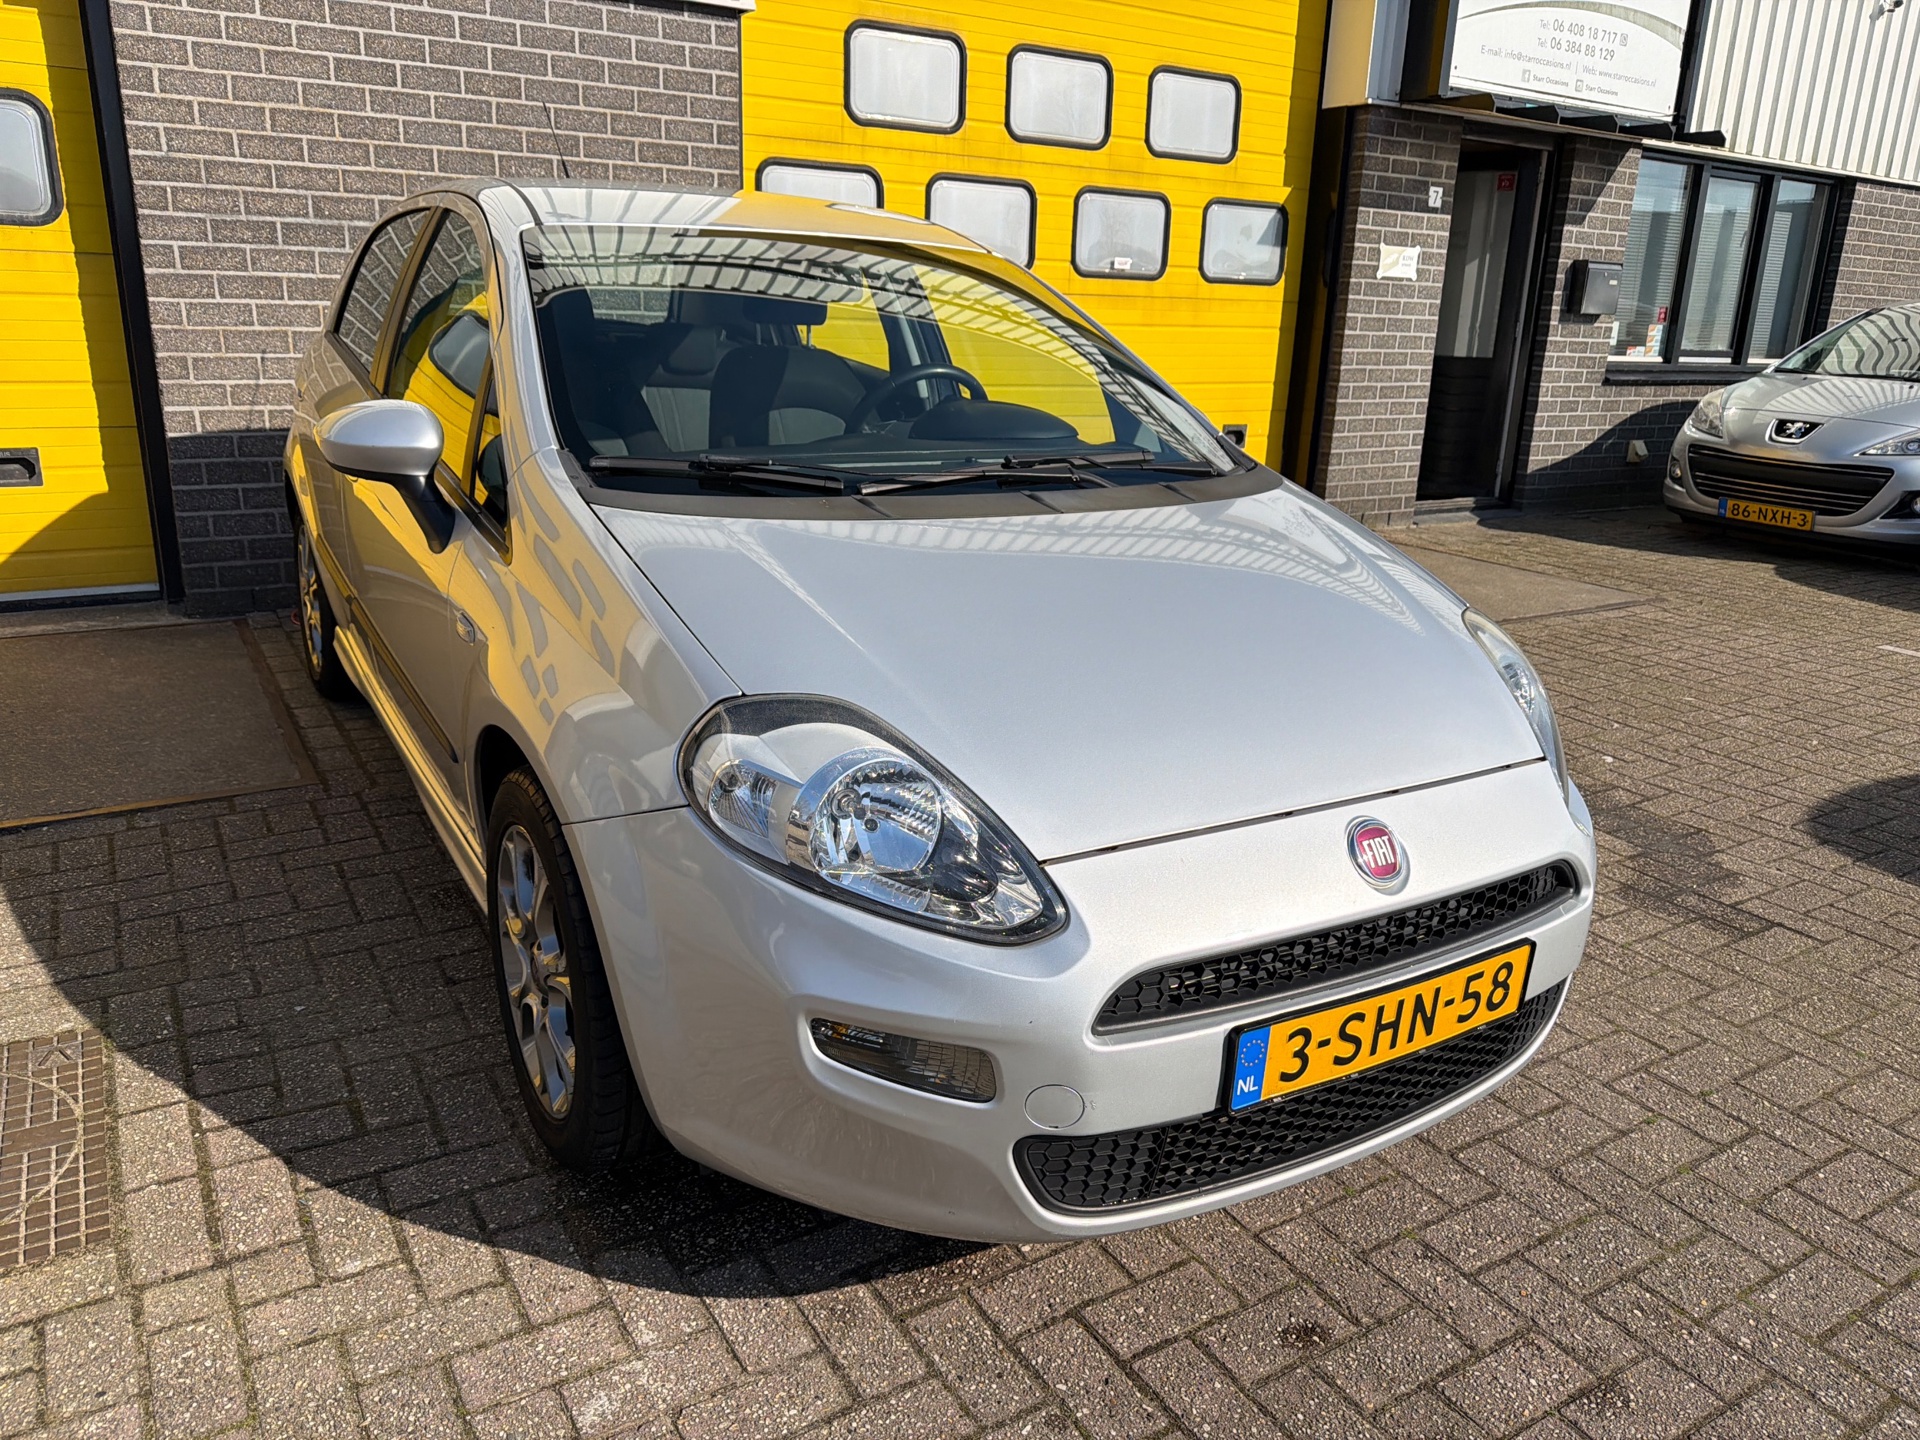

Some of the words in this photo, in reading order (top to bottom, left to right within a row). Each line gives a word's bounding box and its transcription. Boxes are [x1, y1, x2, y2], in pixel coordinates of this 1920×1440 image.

[1540, 19, 1551, 31] Tel:
[1553, 18, 1565, 33] 06
[1567, 22, 1585, 37] 408
[1588, 26, 1599, 40] 18
[1601, 29, 1618, 44] 717
[1537, 37, 1548, 49] Tel:
[1550, 36, 1562, 51] 06
[1564, 39, 1582, 55] 384
[1584, 44, 1596, 58] 88
[1599, 47, 1615, 61] 129
[1480, 44, 1503, 58] E-mail:
[1504, 48, 1572, 71] info@starroccasions.nl
[1582, 64, 1598, 76] Web:
[1598, 69, 1657, 88] www.starroccasions.nl
[1545, 76, 1569, 87] Occasions
[1597, 86, 1619, 97] Occasions
[1433, 190, 1439, 205] 7
[1730, 503, 1808, 528] 86-NXH-3
[1362, 835, 1395, 869] FIAT
[1279, 961, 1514, 1083] 3-SHN-58
[1236, 1075, 1259, 1097] NL
